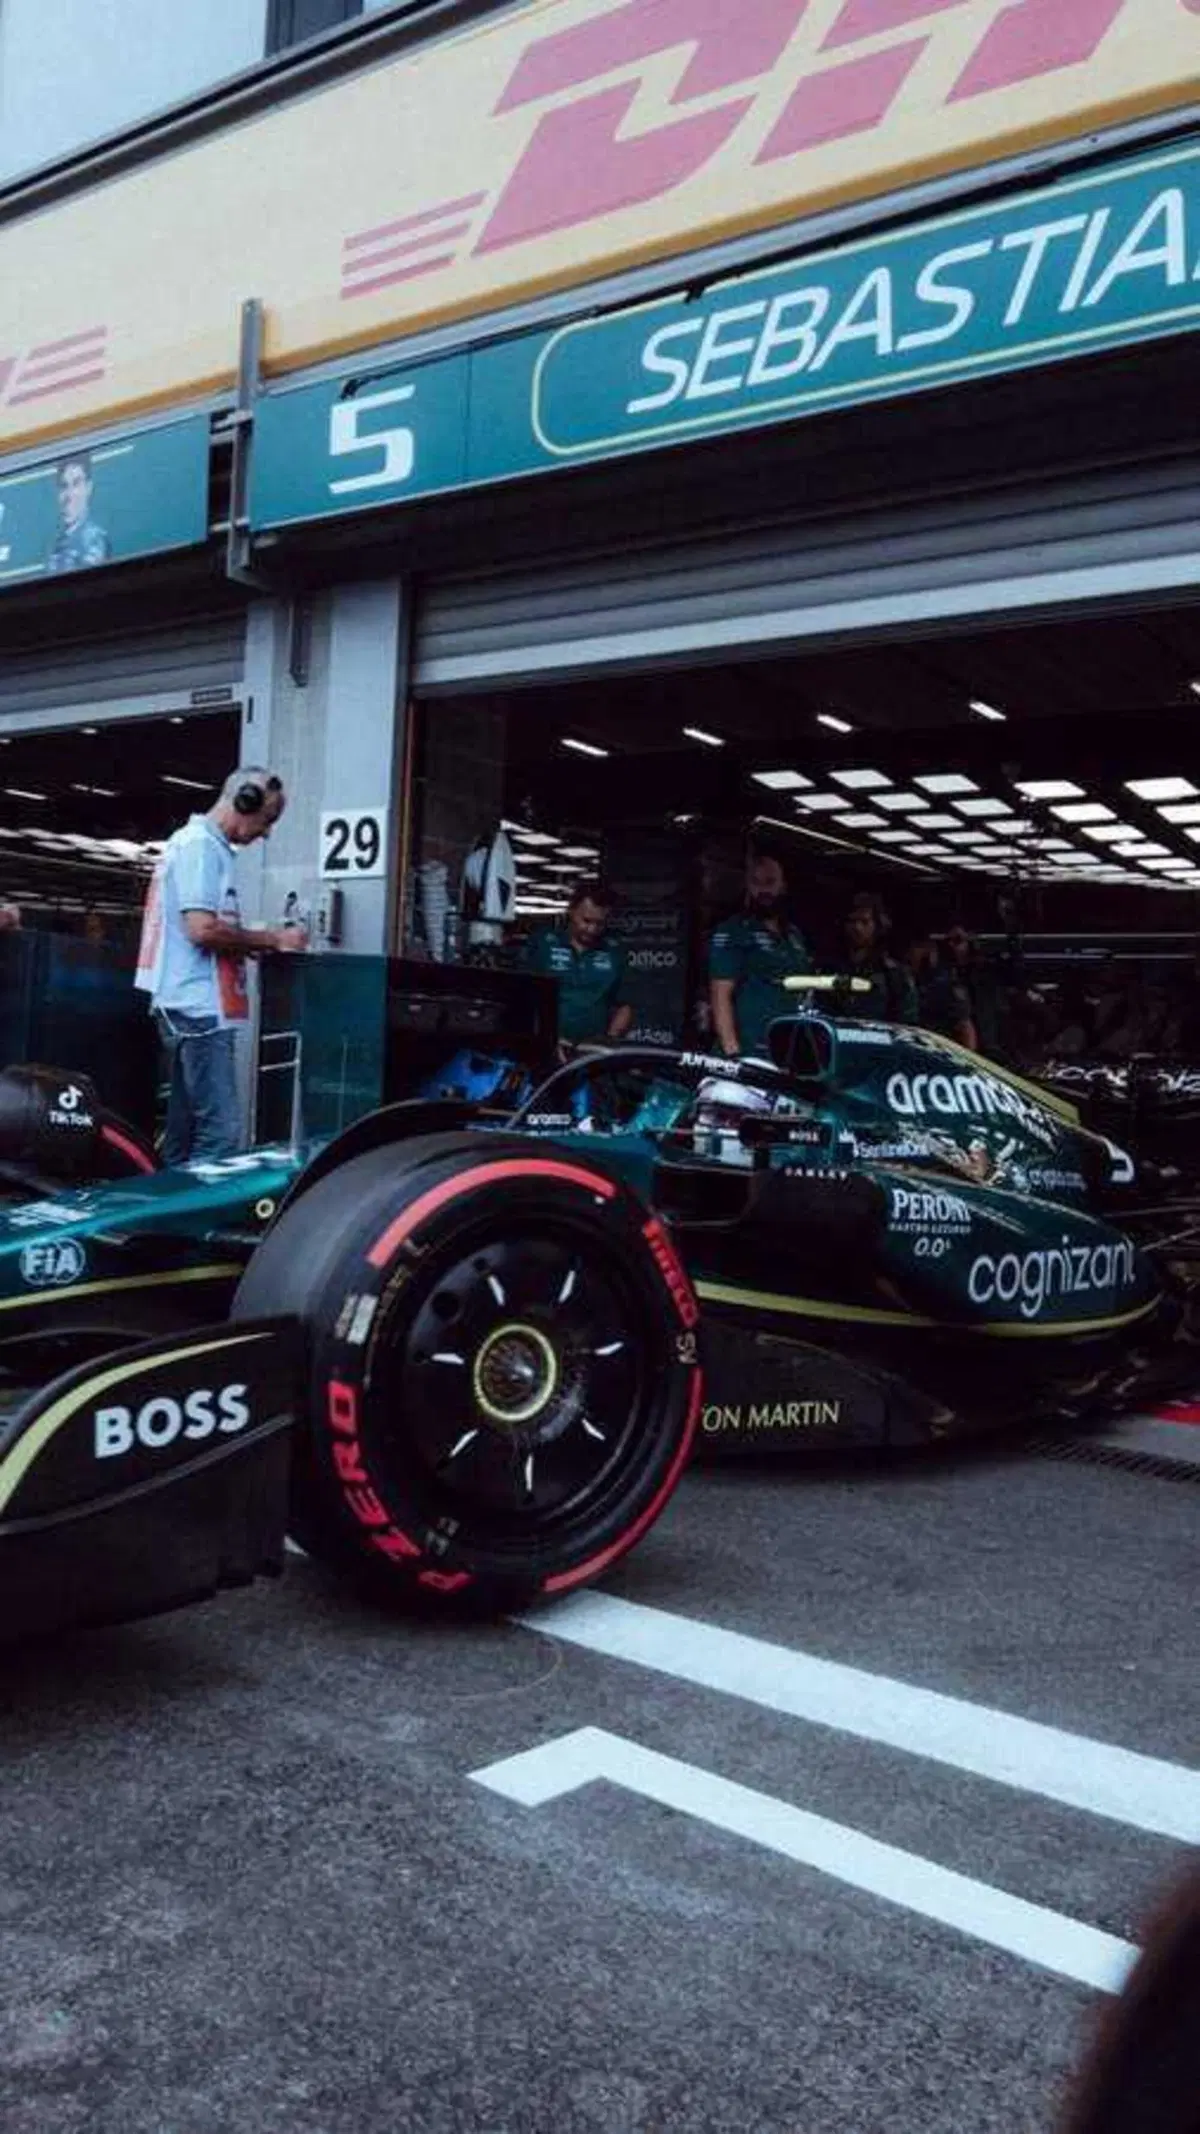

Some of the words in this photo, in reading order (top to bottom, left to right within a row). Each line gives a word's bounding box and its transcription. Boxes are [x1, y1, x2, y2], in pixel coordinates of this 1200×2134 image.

[474, 0, 1200, 256] DH
[626, 188, 1200, 413] SEBASTIA
[329, 385, 415, 494] 5
[324, 816, 381, 871] 29
[50, 1111, 93, 1126] TikTok
[886, 1072, 1025, 1117] aramco
[891, 1188, 971, 1222] PERONI
[26, 1247, 78, 1275] FIA
[968, 1235, 1136, 1317] cognizant
[94, 1384, 250, 1459] BOSS
[702, 1405, 741, 1431] ON
[748, 1402, 840, 1429] MARTIN
